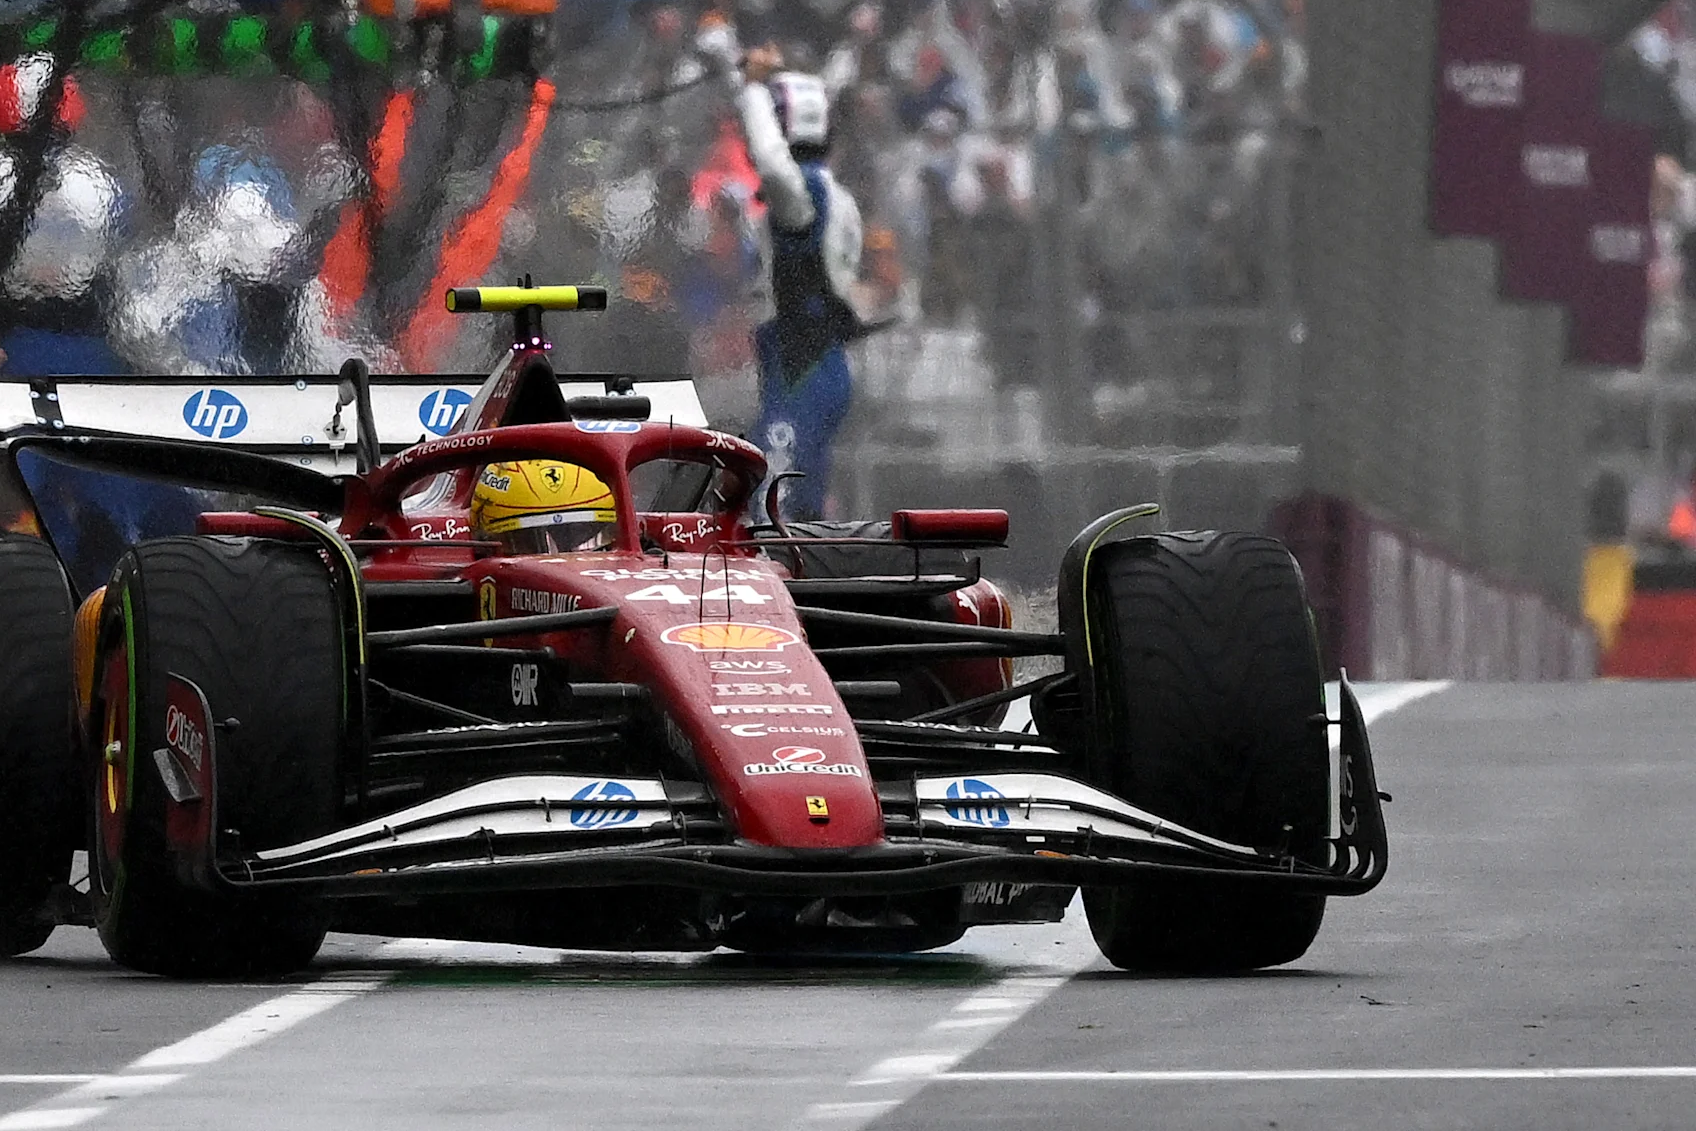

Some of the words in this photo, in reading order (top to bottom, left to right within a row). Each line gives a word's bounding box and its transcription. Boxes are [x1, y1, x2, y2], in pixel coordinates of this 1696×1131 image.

[189, 389, 242, 439] hp
[415, 434, 495, 458] TECHNOLOGY
[410, 519, 470, 541] Ray-Ban
[511, 587, 550, 614] RICHARD
[625, 584, 773, 605] 44
[710, 660, 786, 670] aws
[710, 683, 812, 696] IBM
[710, 704, 833, 715] PIRELLI
[745, 762, 860, 775] UniCredit
[574, 781, 634, 828] hp
[953, 779, 1002, 828] hp
